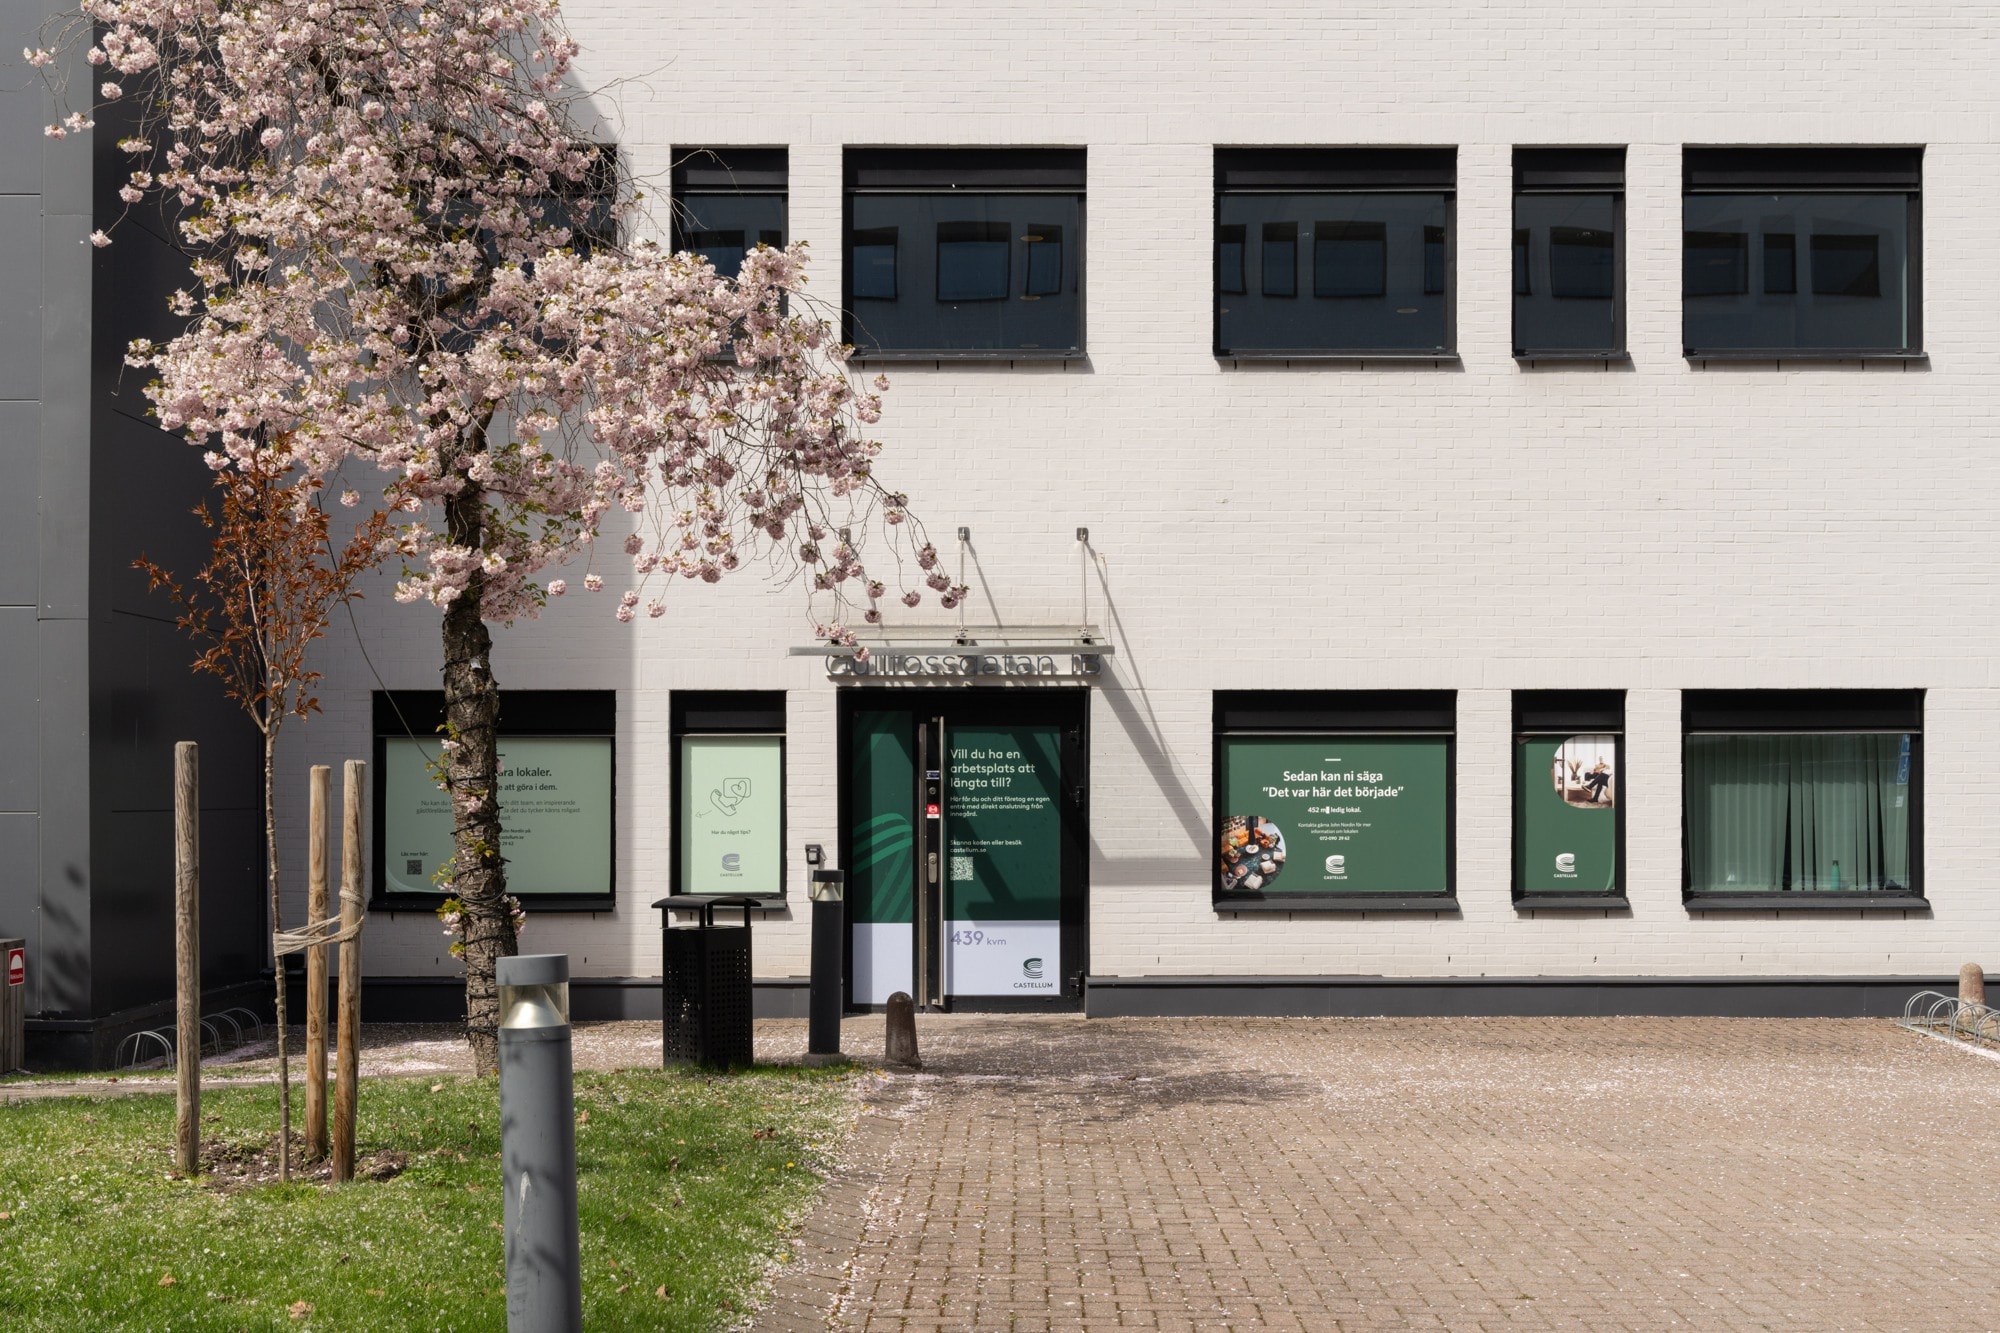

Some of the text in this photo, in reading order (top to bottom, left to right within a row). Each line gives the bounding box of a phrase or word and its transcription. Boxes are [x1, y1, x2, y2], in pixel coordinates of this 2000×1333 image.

[826, 654, 1054, 678] Gullfossgatan
[950, 749, 968, 759] Vill
[970, 749, 985, 759] du
[988, 749, 1003, 759] ha
[516, 766, 552, 776] lokaler.
[950, 763, 1015, 776] arbetsplats
[1018, 763, 1036, 773] att
[1283, 771, 1383, 783] Sedan kan ni säga
[516, 782, 534, 792] göra
[950, 777, 1012, 790] längta till?
[1312, 786, 1331, 797] här
[1333, 786, 1352, 797] det
[950, 930, 984, 946] 439
